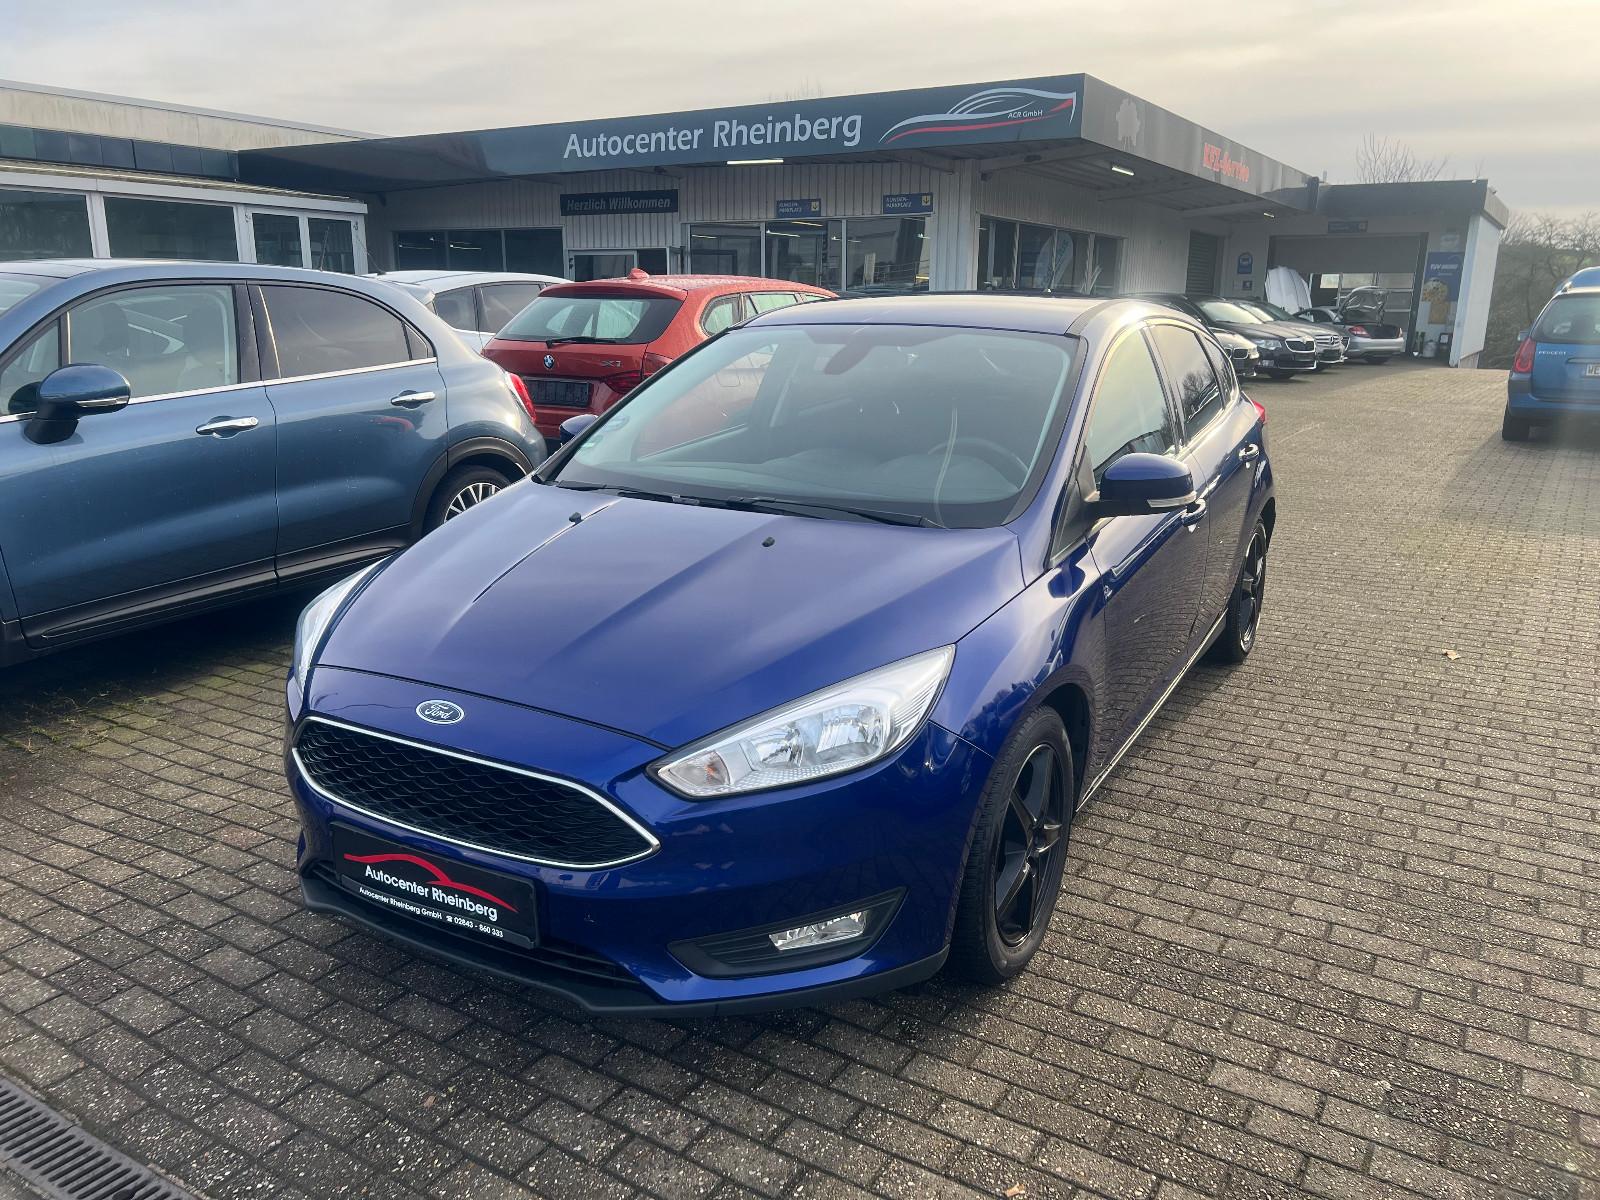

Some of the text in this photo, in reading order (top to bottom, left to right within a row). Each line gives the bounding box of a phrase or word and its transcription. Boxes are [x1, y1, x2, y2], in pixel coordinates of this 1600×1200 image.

[1022, 110, 1043, 118] GmbH
[563, 113, 862, 159] Autocenter Rheinberg
[567, 196, 671, 211] Herzlich Willkommen
[424, 703, 454, 720] Ford
[359, 886, 390, 904] Autocenter
[390, 897, 421, 915] Rheinberg
[421, 908, 443, 920] GmbH
[365, 865, 498, 921] Autocenter Rheinberg
